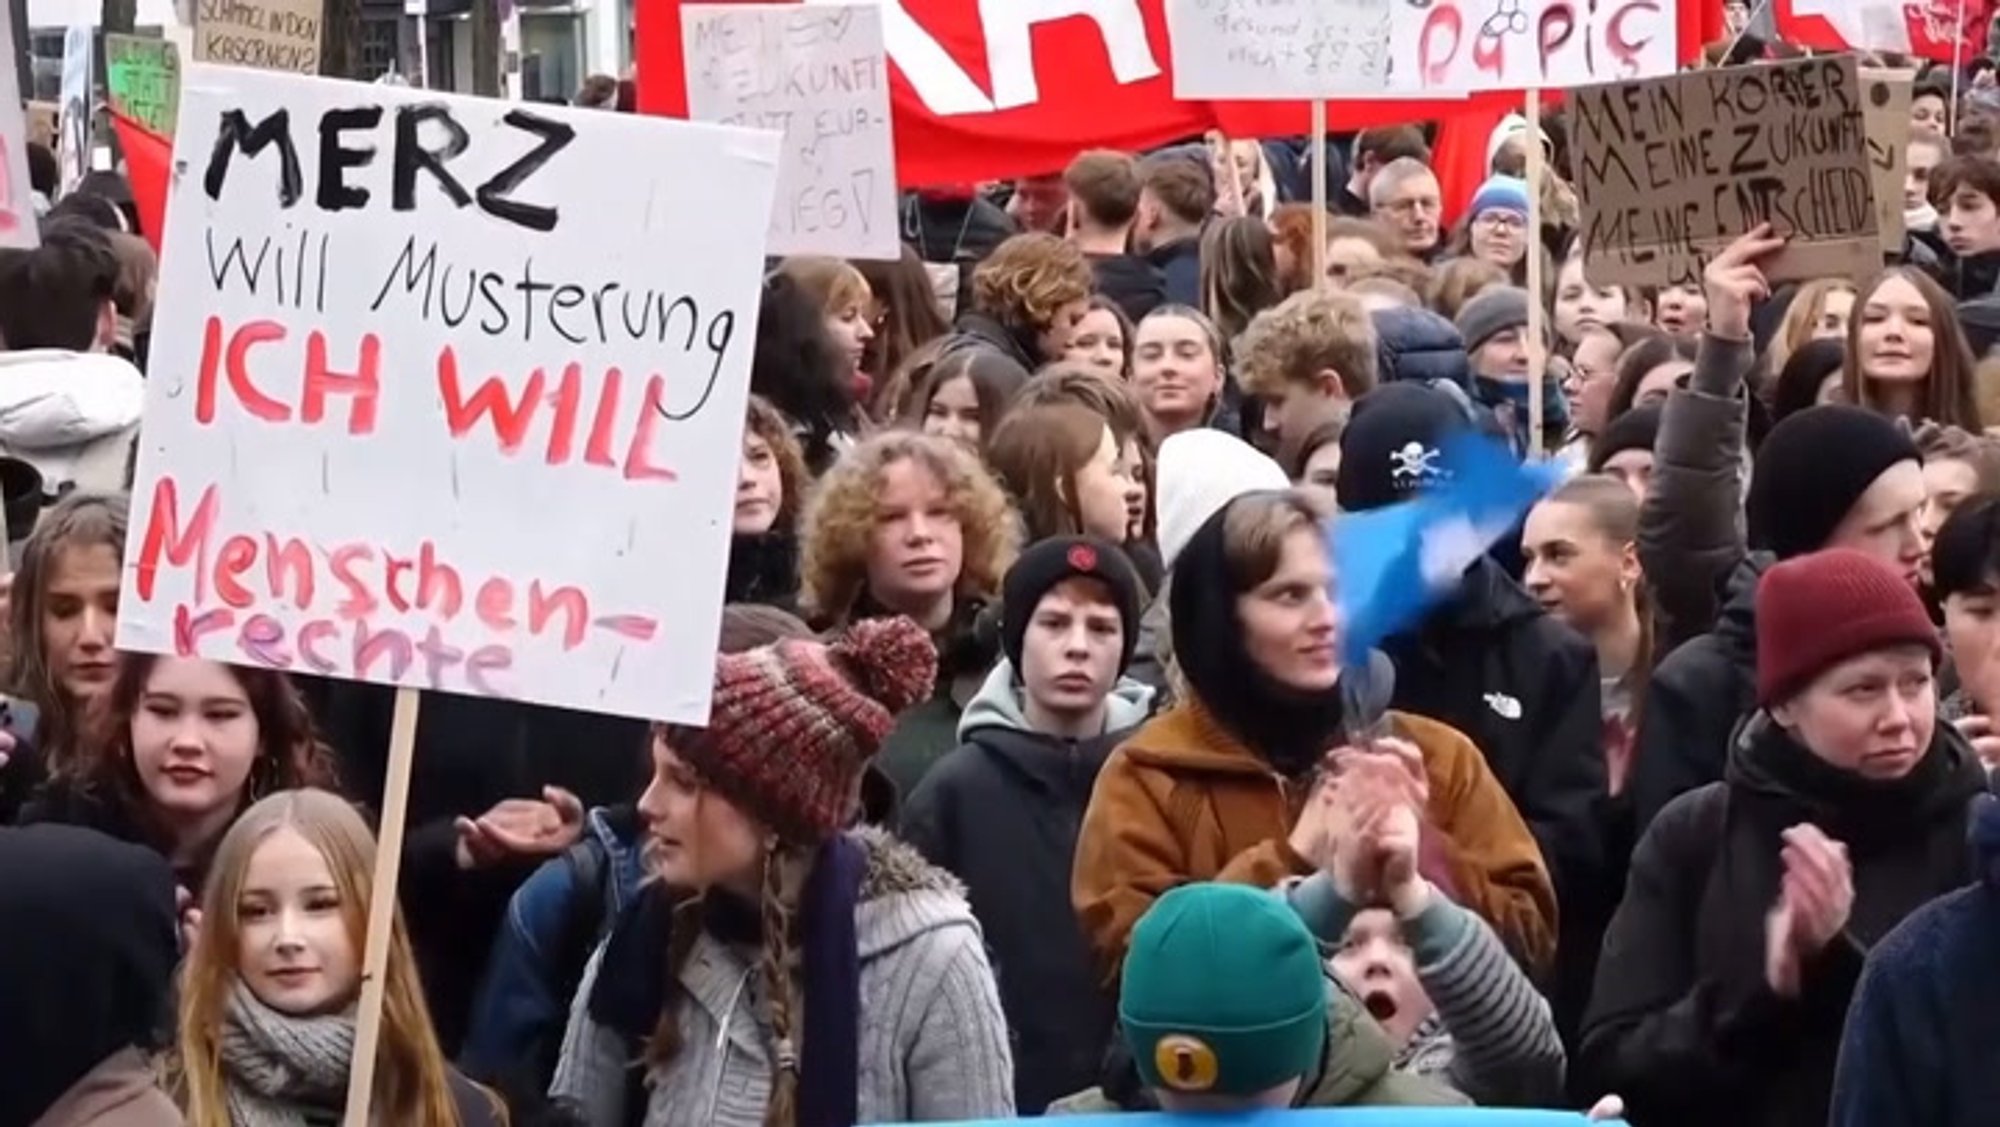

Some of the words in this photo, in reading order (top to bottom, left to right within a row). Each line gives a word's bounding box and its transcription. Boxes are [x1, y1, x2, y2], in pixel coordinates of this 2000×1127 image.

[1572, 79, 1685, 144] MEIN
[1580, 127, 1719, 204] MEINE
[204, 105, 574, 231] MERZ
[1584, 203, 1701, 266] MEINE
[371, 235, 735, 420] Musterung
[195, 315, 381, 434] ICH
[438, 344, 677, 480] WILL
[134, 476, 659, 651] Menschen-
[173, 603, 515, 694] rechte
